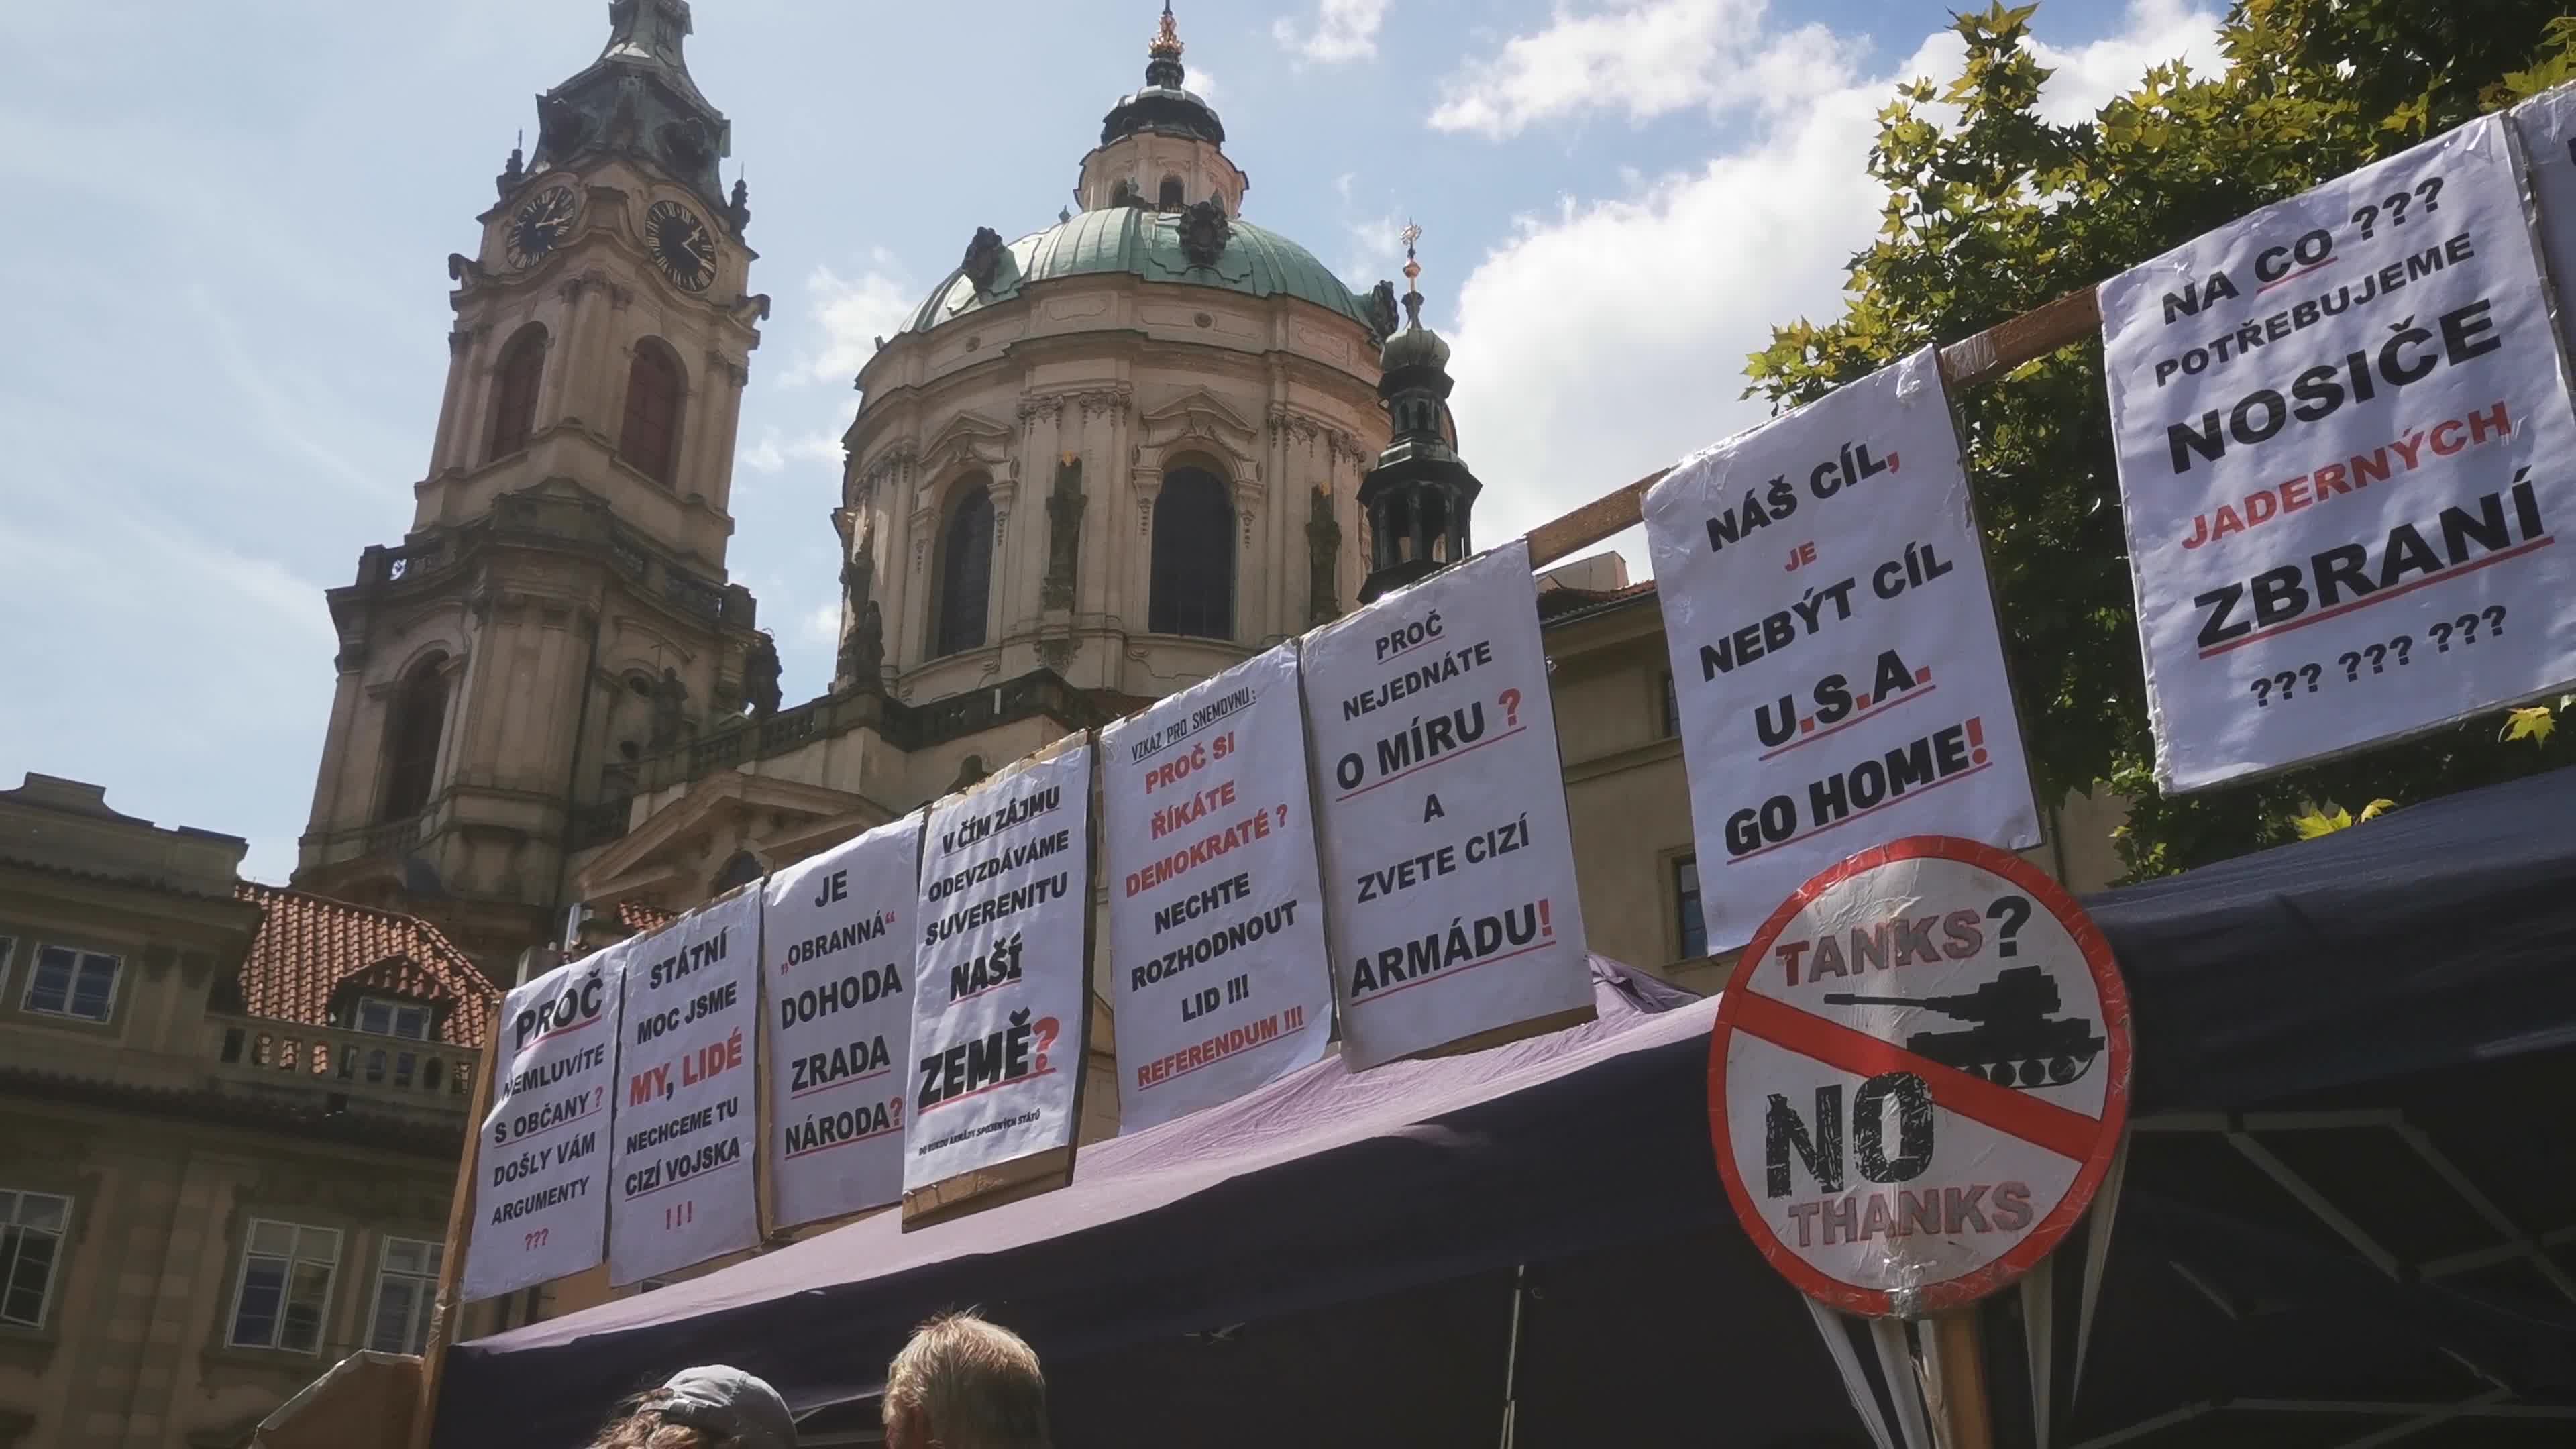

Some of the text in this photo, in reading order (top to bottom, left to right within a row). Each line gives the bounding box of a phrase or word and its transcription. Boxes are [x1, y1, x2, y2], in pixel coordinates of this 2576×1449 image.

[2161, 176, 2445, 325] NA CO ???
[2155, 232, 2475, 388] POTŘEBUJEME
[2166, 298, 2502, 474] NOSIČE
[1705, 441, 1900, 552] NÁŠ CÍL,
[2180, 400, 2511, 550] JADERNÝCH
[1784, 541, 1817, 572] JE
[2193, 464, 2545, 649] ZBRANÍ
[1375, 608, 1444, 660] PROČ
[1699, 540, 1954, 682] NEBÝT CÍL
[1343, 641, 1493, 721] NEJEDNÁTE
[2250, 605, 2507, 708] ??? ??? ???
[1754, 649, 1932, 747] U.S.A.
[1132, 732, 1161, 761] VZKAZ
[1167, 719, 1187, 743] PRO
[1145, 731, 1234, 795] PROČ SI
[1336, 752, 1364, 790] O
[1377, 701, 1486, 777] MÍRU
[943, 786, 1059, 854] V ČÍM ZÁJMU
[1151, 780, 1235, 840] ŘÍKÁTE
[1424, 794, 1445, 824] A
[1725, 716, 1988, 856] GO HOME!
[928, 829, 1068, 902] ODEVZDÁVÁME
[1125, 806, 1270, 898] DEMOKRATÉ
[1357, 812, 1530, 904] ZVETE CIZÍ
[815, 869, 848, 908] JE
[925, 872, 1067, 946] SUVERENITU
[1155, 873, 1250, 934] NECHTE
[650, 926, 729, 989] STÁTNÍ
[950, 932, 1022, 1000] NAŠÍ
[1132, 900, 1297, 992] ROZHODNOUT
[1350, 898, 1553, 998] ARMÁDU!
[1776, 896, 2031, 987] TANKS?
[516, 969, 603, 1050] PROČ
[637, 981, 737, 1046] MOC JSME
[782, 963, 902, 1030] DOHODA
[1182, 987, 1220, 1022] LID
[503, 1044, 604, 1097] NEMLUVÍTE
[629, 1026, 742, 1106] MY, LIDÉ
[792, 1035, 890, 1093] ZRADA
[918, 1006, 1060, 1110] ZEMĚ?
[1138, 1014, 1277, 1087] REFERENDUM
[495, 1122, 506, 1143] S
[515, 1091, 590, 1138] OBČANY
[626, 1097, 738, 1155] NECHCEME TU
[785, 1096, 903, 1155] NÁRODA?
[1765, 1072, 1935, 1199] NO
[494, 1132, 595, 1187] DOŠLY VÁM
[625, 1138, 739, 1196] CIZÍ VOJSKA
[491, 1177, 590, 1225] ARGUMENTY
[1788, 1180, 2033, 1248] THANKS
[525, 1229, 548, 1251] ???
